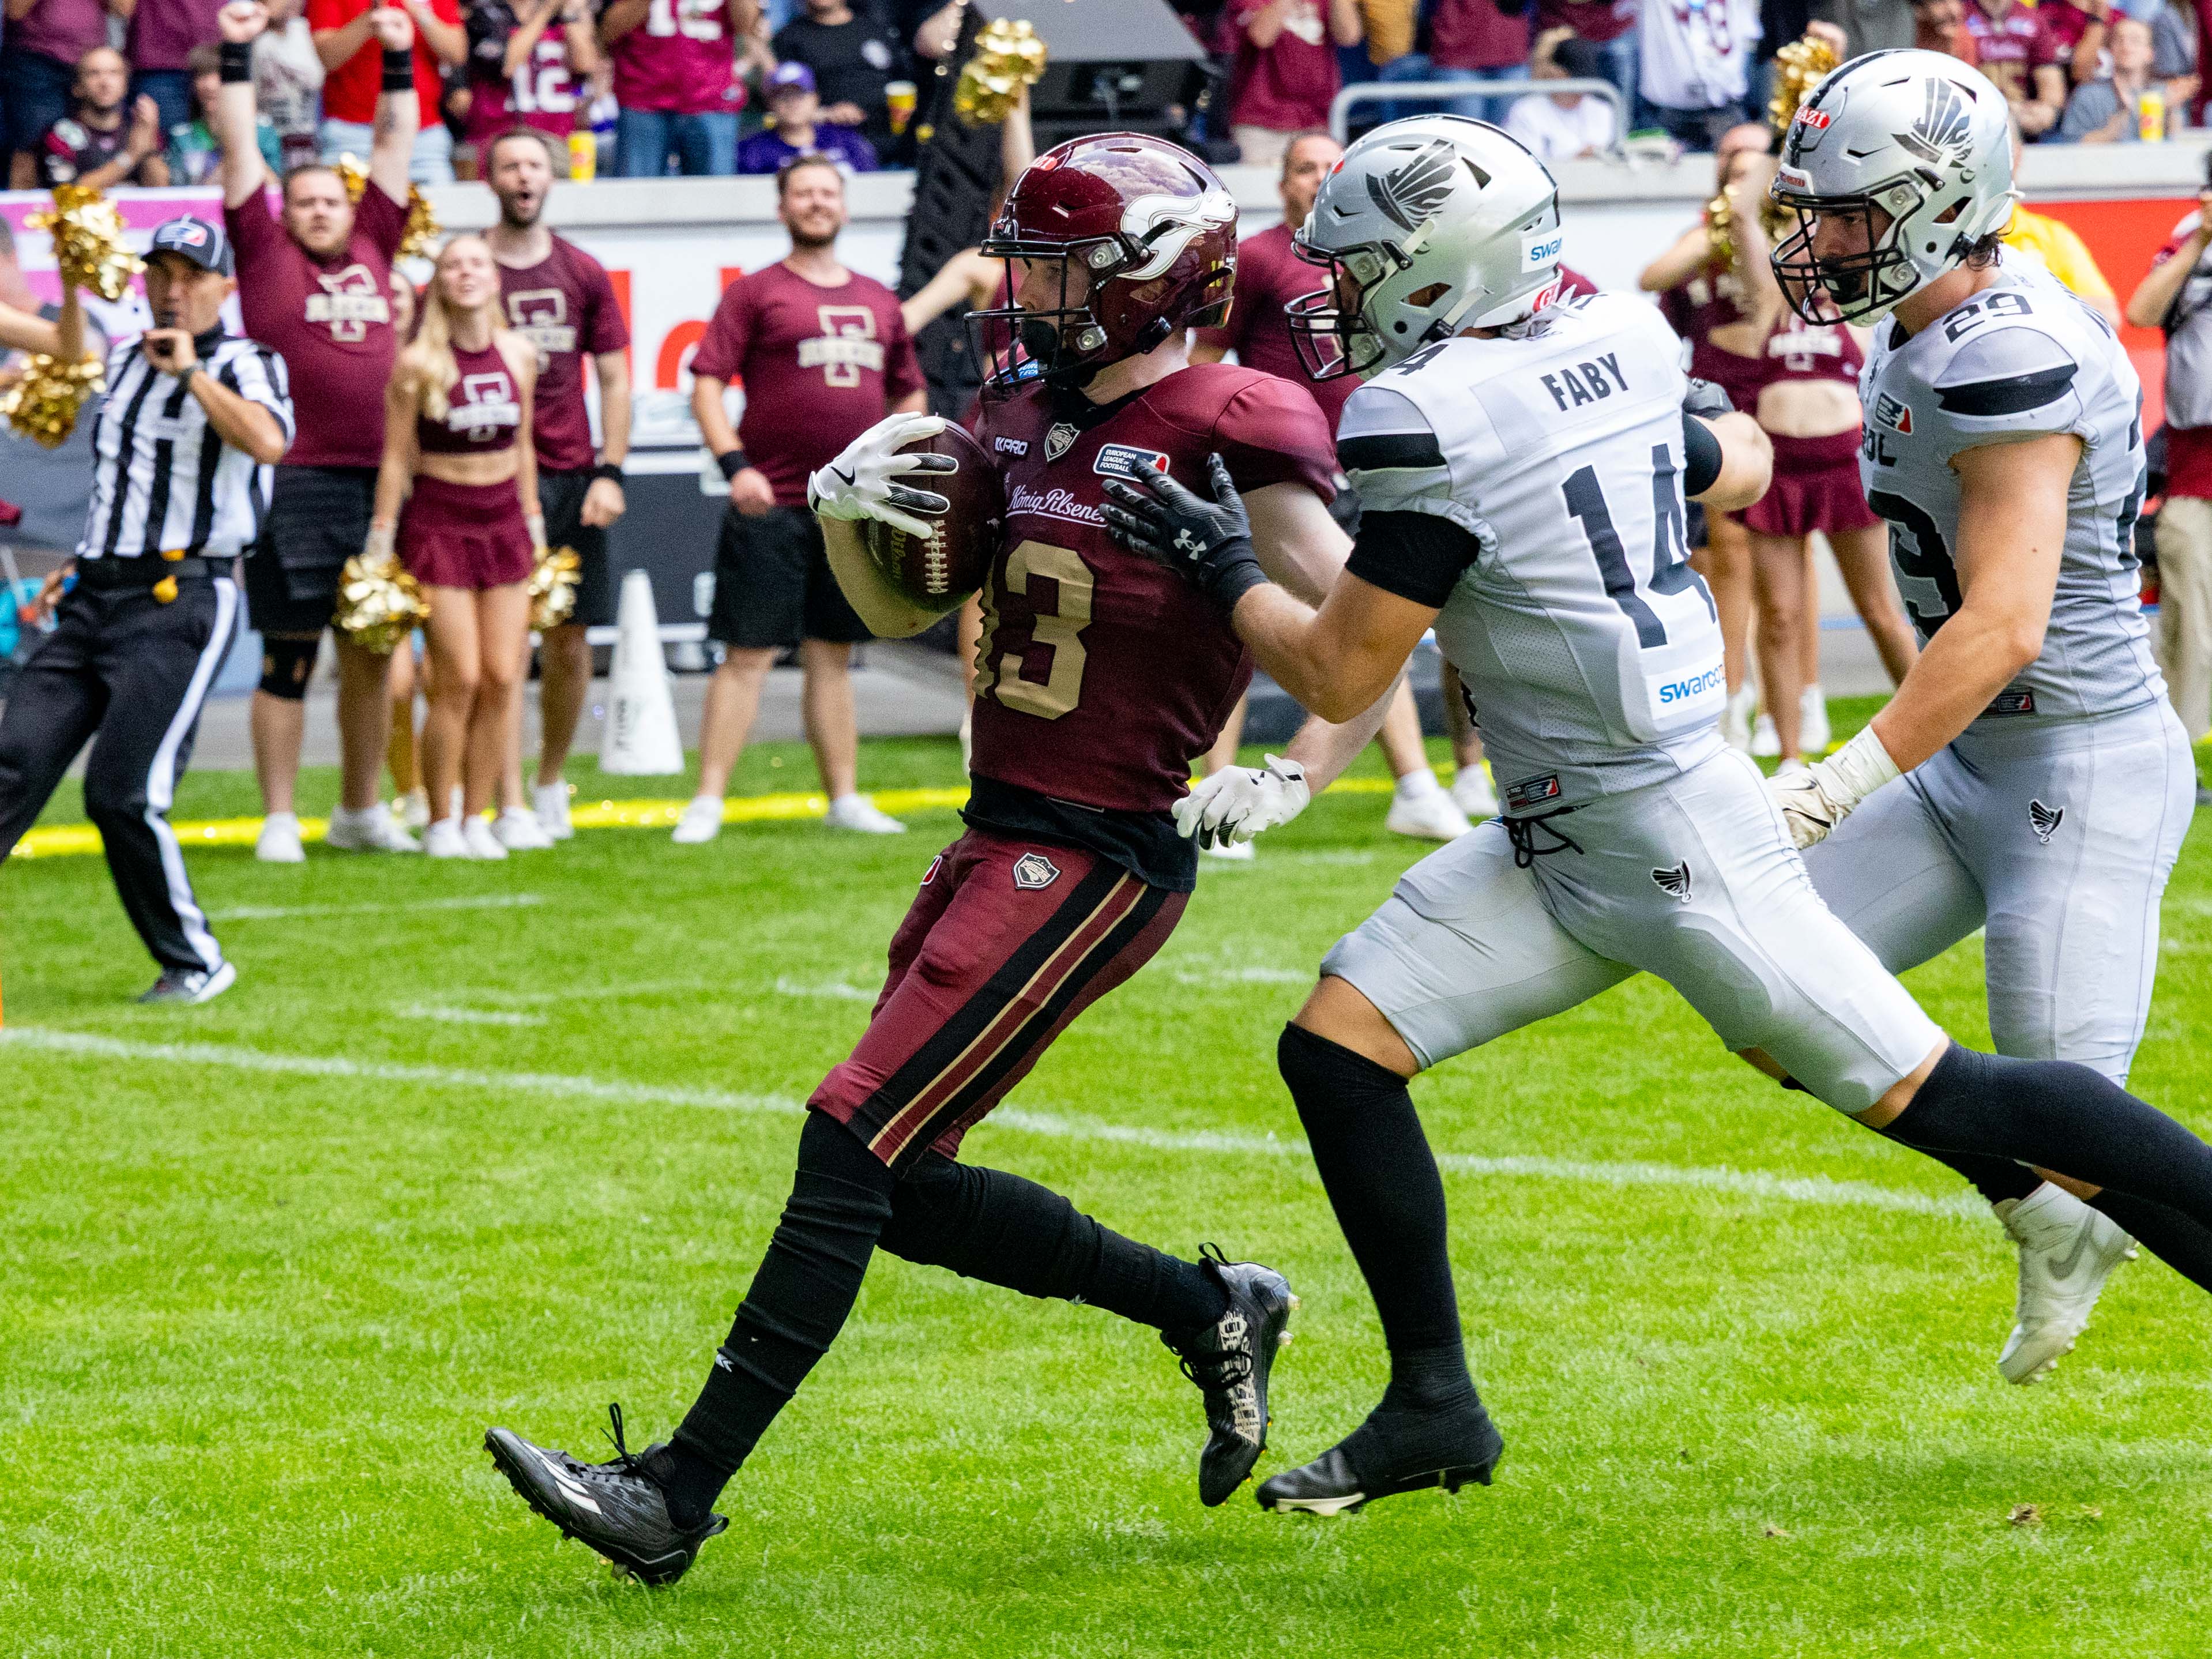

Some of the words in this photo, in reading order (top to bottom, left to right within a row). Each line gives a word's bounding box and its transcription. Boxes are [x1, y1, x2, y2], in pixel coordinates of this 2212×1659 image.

[1942, 293, 2033, 344] 29
[1539, 352, 1629, 412] FABY
[1100, 462, 1130, 472] FOOTBALL
[1103, 456, 1124, 464] LEAGUE
[1105, 449, 1137, 460] EUROPEAN
[1007, 485, 1044, 513] König
[1561, 442, 1716, 649] 14
[1659, 667, 1721, 704] swarco
